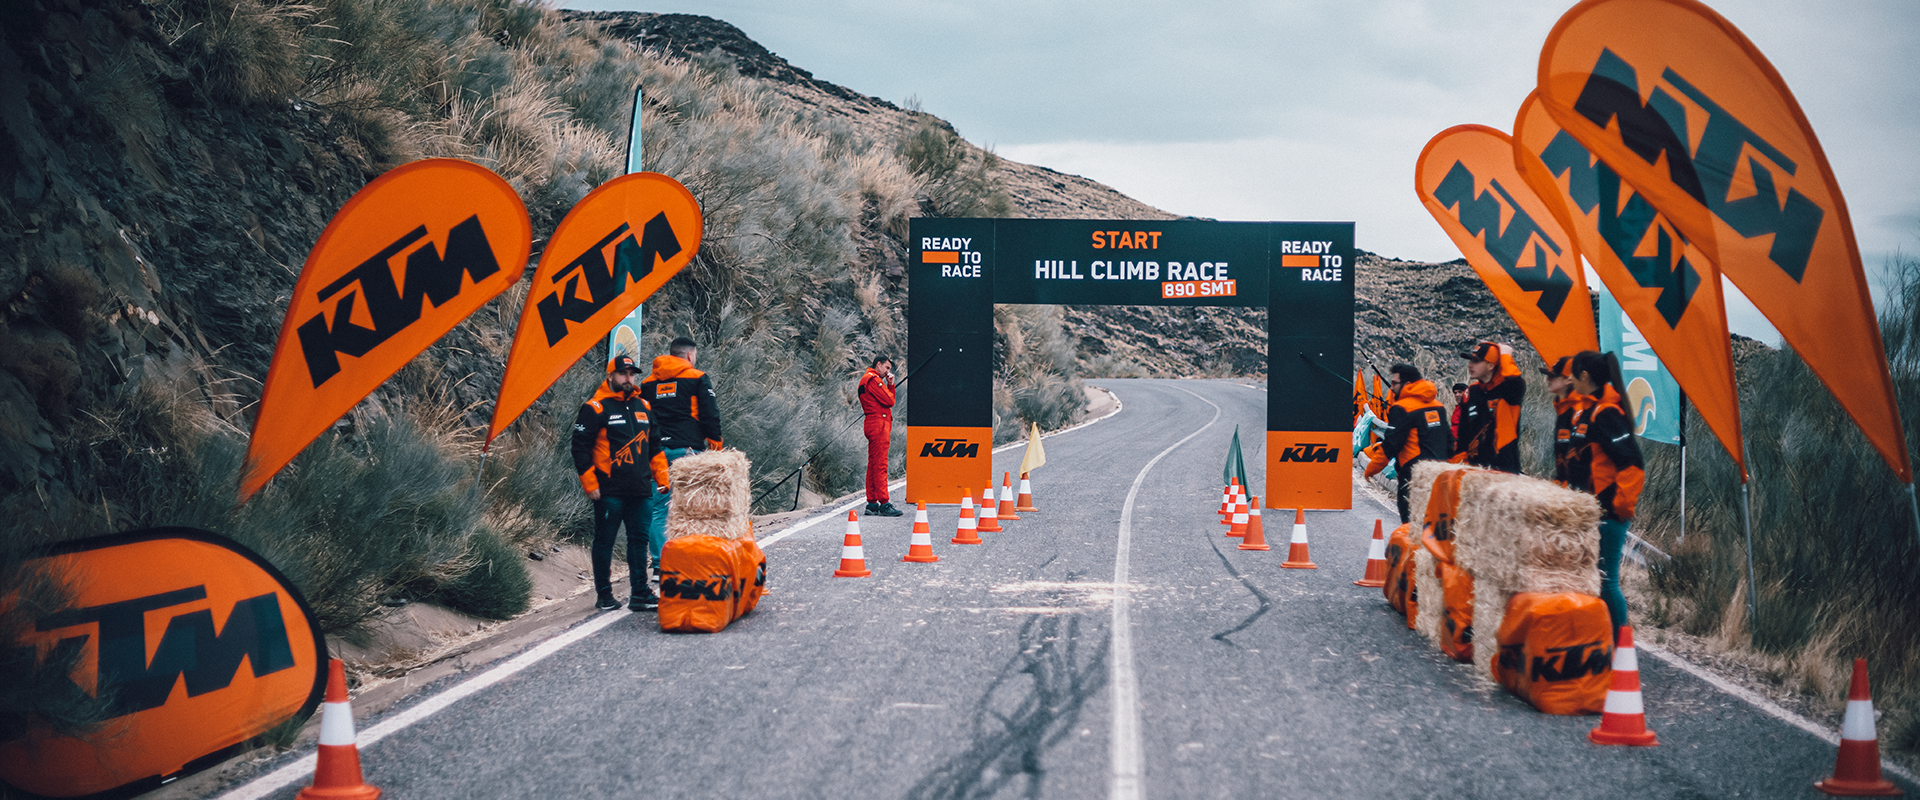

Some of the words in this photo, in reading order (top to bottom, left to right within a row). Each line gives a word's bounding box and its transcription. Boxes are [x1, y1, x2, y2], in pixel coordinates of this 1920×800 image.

[921, 237, 972, 251] READY
[1091, 231, 1162, 250] START
[1281, 241, 1333, 254] READY
[961, 252, 982, 264] TO
[1322, 255, 1342, 267] TO
[941, 264, 982, 278] RACE
[1035, 260, 1083, 279] HILL
[1090, 261, 1160, 280] CLIMB
[1167, 262, 1228, 281] RACE
[1302, 268, 1342, 281] RACE
[536, 210, 683, 348] KTM
[1164, 284, 1196, 297] 890
[1200, 282, 1234, 296] SMT
[296, 214, 501, 389] KTM
[920, 439, 979, 458] KTM
[1280, 443, 1339, 463] KTM
